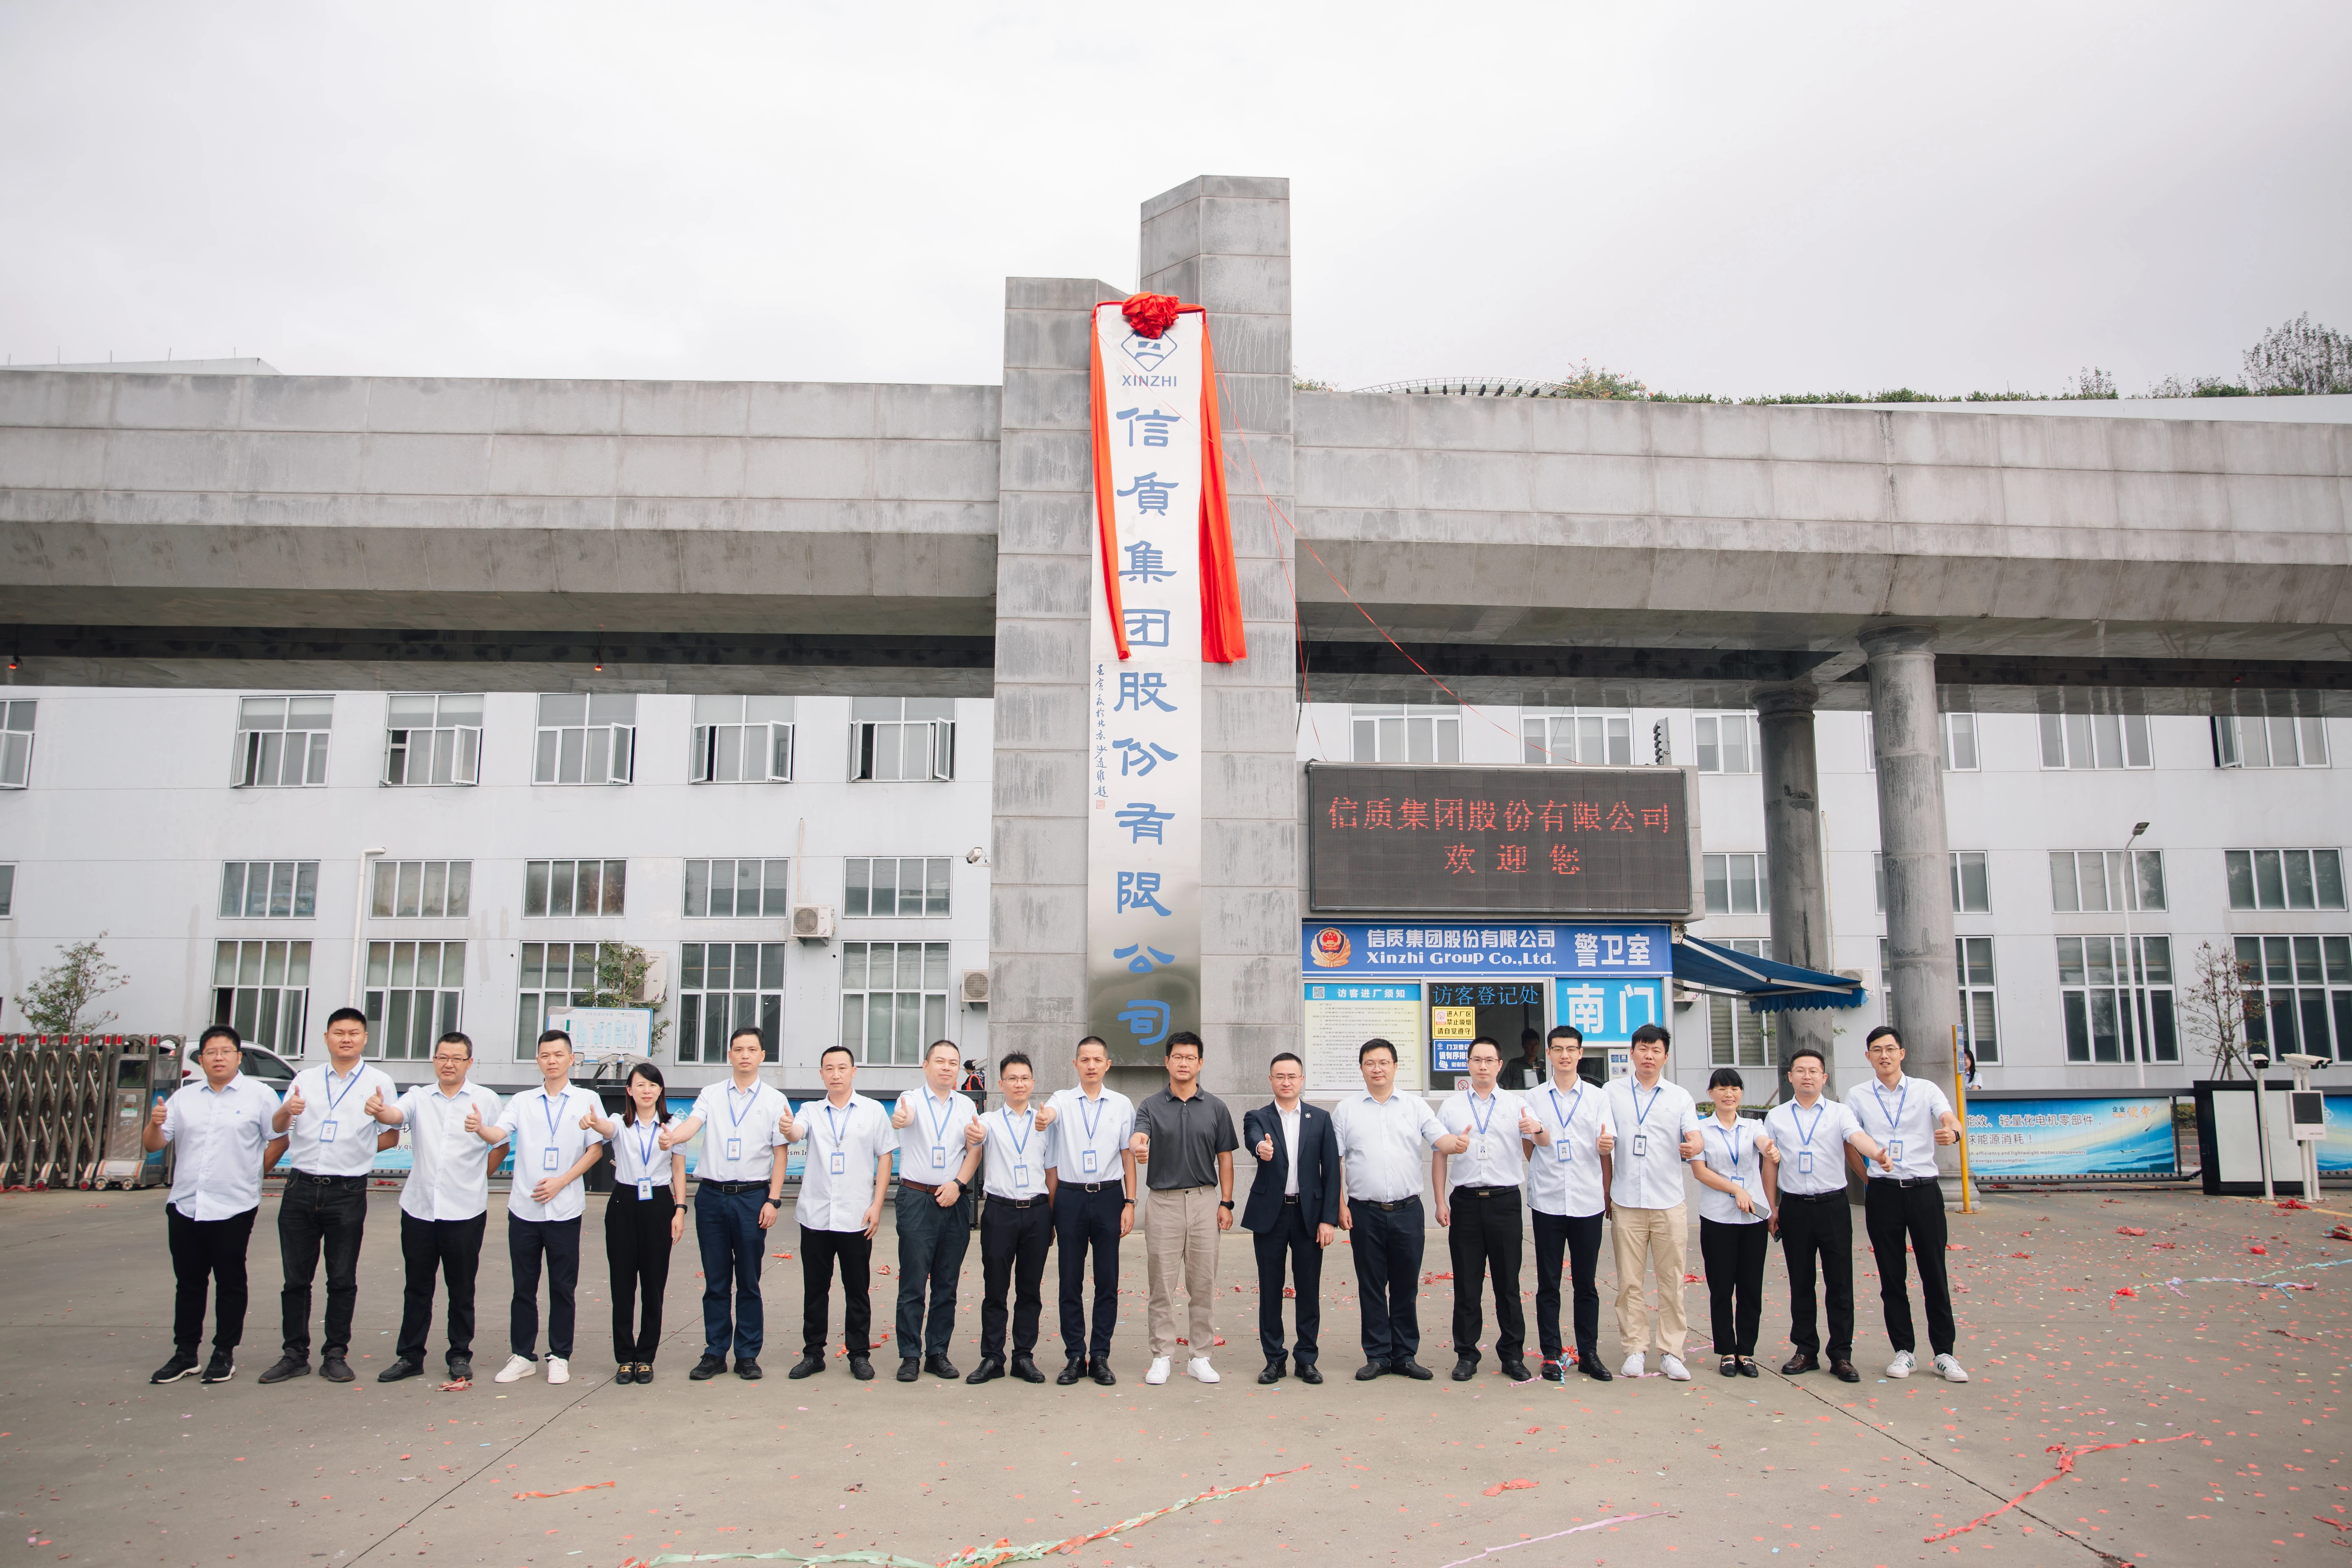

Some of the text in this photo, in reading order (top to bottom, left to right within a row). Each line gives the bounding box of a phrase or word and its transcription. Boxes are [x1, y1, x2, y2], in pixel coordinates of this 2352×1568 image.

[1122, 376, 1177, 387] XINZHI
[1327, 797, 1669, 833] 信质集团股份有限公司
[1444, 843, 1580, 875] 欢迎您
[1367, 929, 1555, 949] 信质集团股份有限公司
[1366, 951, 1557, 966] Xinzhi Group Co.,Ltd.
[1574, 933, 1651, 967] 警卫室
[1337, 989, 1405, 998] 访客进厂须知
[1432, 985, 1539, 1005] 访客登记处
[1567, 983, 1656, 1034] 南门
[1439, 1051, 1468, 1060] 请有序排
